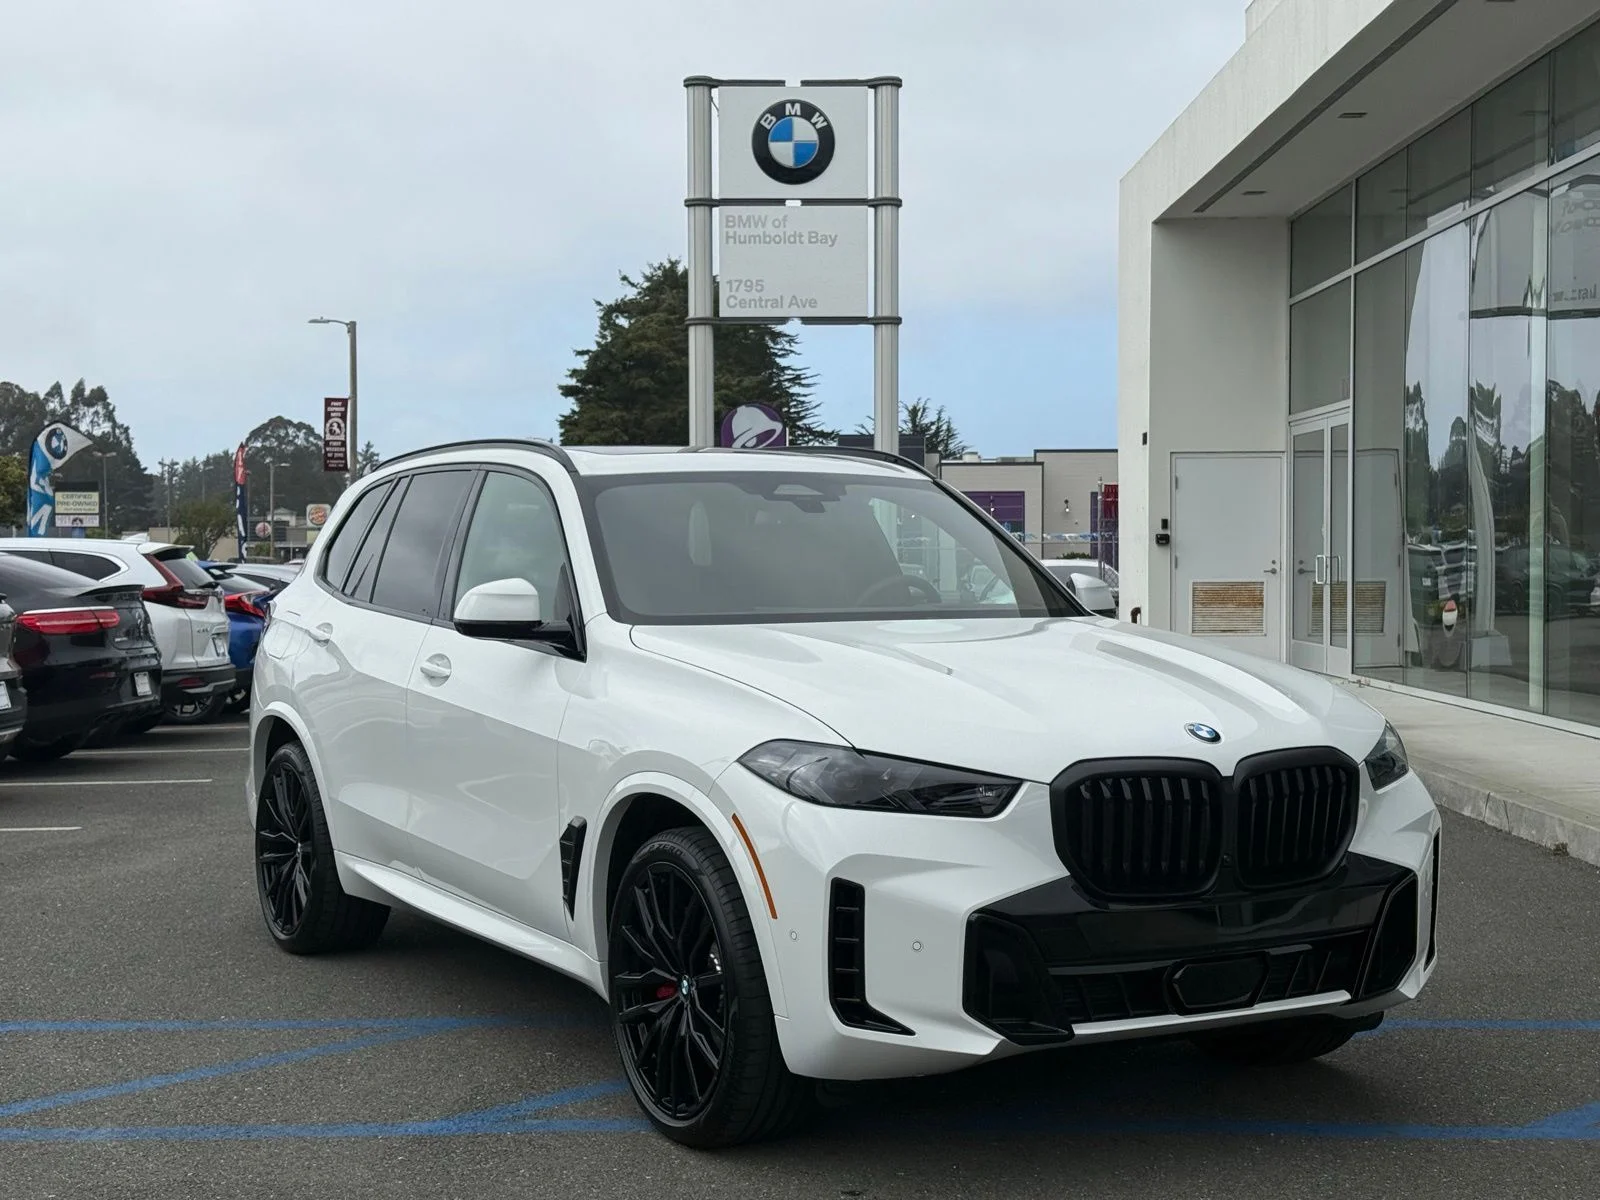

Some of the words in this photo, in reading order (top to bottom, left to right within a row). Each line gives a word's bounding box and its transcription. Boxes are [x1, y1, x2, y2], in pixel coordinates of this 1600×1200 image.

[760, 103, 827, 130] BMW
[725, 215, 767, 229] BMW
[771, 215, 788, 229] of
[725, 230, 804, 245] Humboldt
[808, 230, 838, 248] Bay
[726, 279, 765, 293] 1795
[726, 295, 784, 309] Central
[787, 295, 818, 309] Ave
